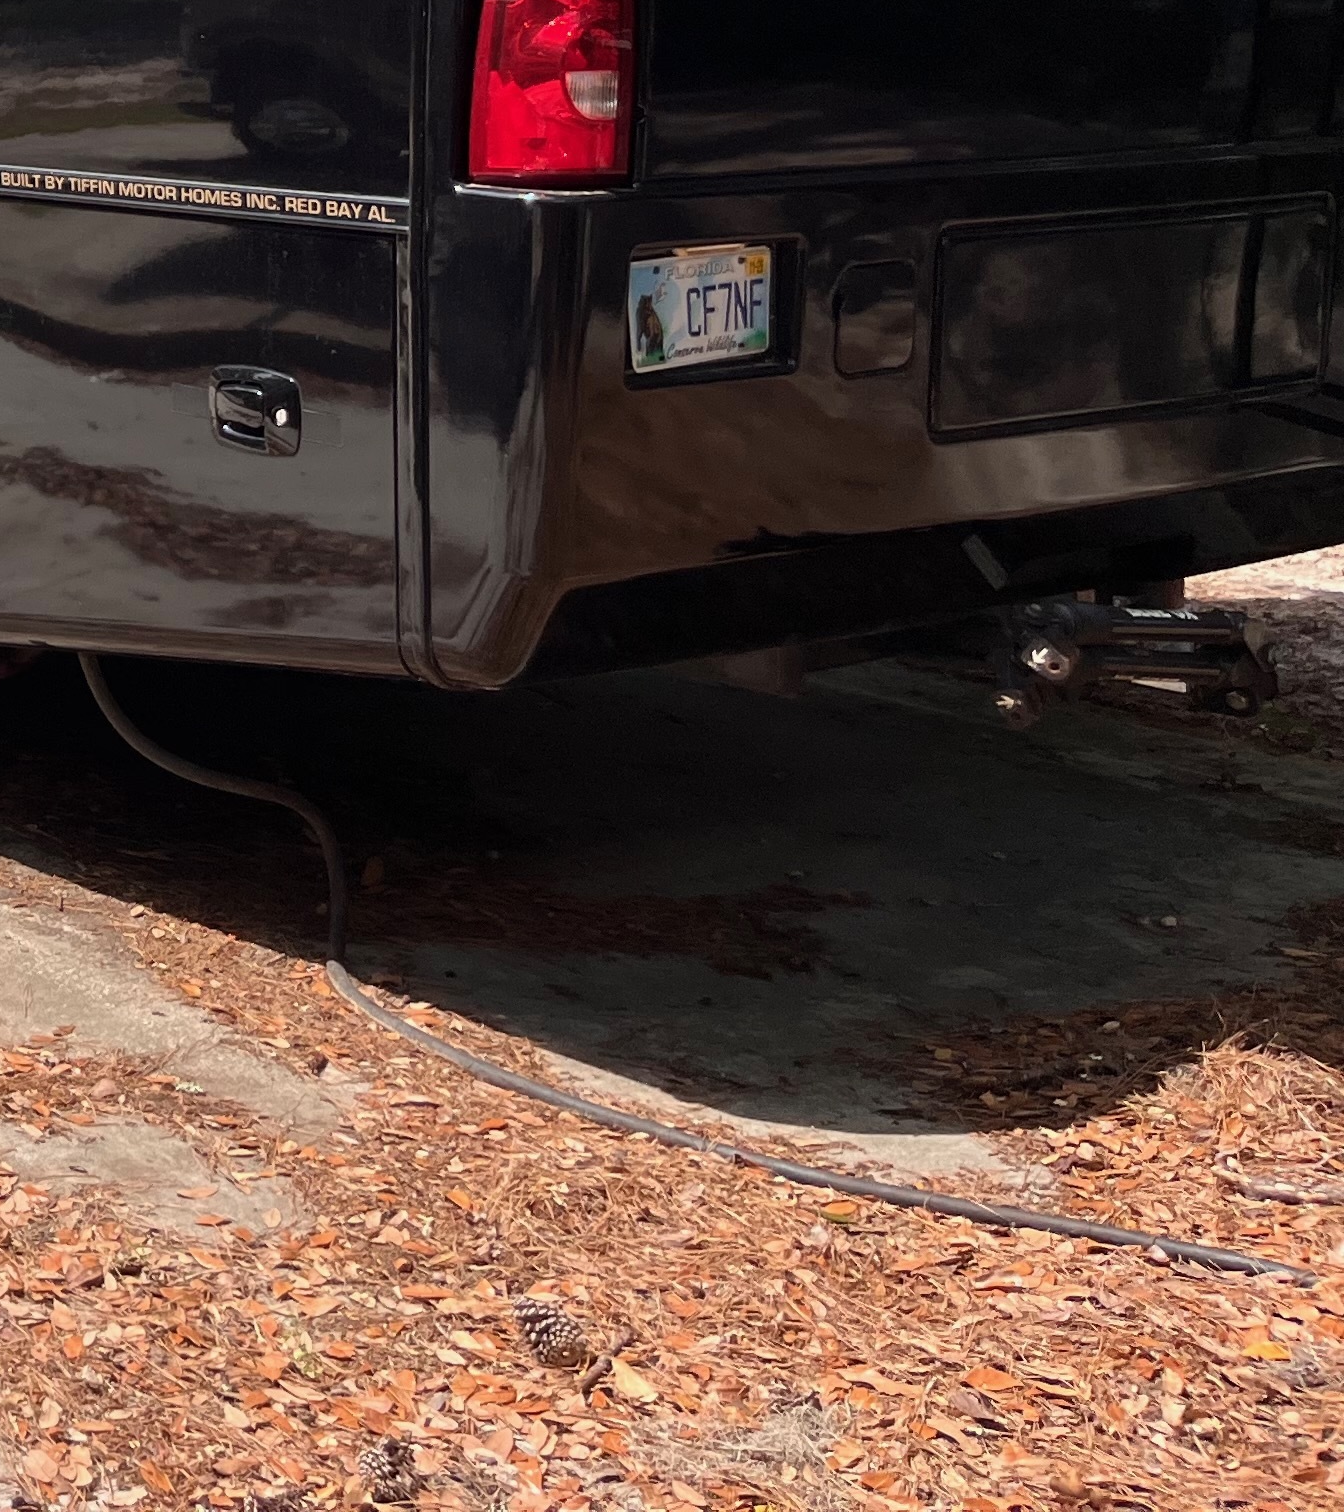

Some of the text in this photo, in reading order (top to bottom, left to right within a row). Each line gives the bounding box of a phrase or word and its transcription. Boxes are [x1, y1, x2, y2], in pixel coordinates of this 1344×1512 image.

[0, 172, 397, 223] BUILT BY TIFFIN MOTOR HOMES INC. RED BAY AL.
[664, 261, 735, 281] FLORIDA
[686, 277, 764, 337] CF7NF
[666, 342, 704, 359] Conserve
